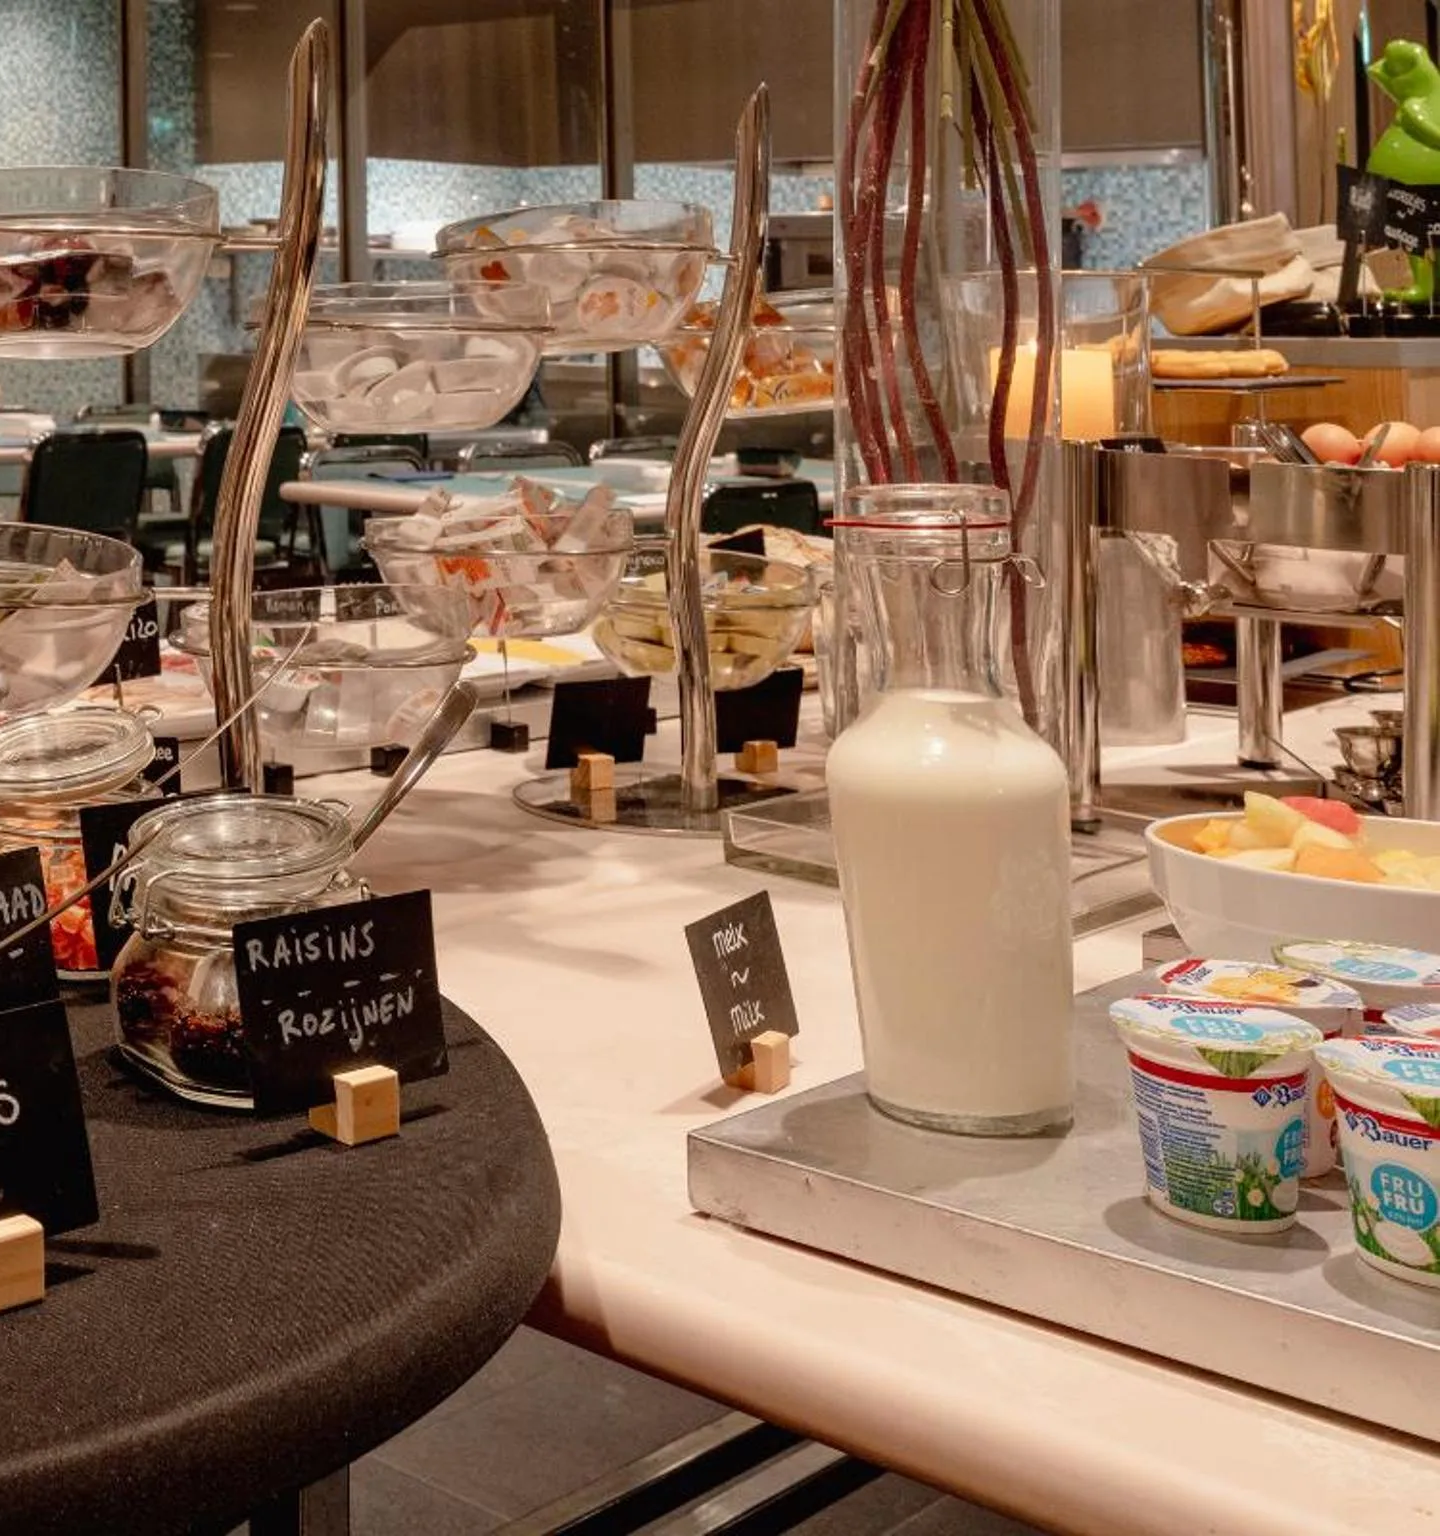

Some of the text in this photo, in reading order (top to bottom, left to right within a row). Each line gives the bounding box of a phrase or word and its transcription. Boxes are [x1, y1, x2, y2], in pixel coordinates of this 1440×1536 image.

[1360, 1116, 1433, 1151] Bauer
[1380, 1172, 1423, 1197] FRU
[1383, 1190, 1425, 1215] FRU
